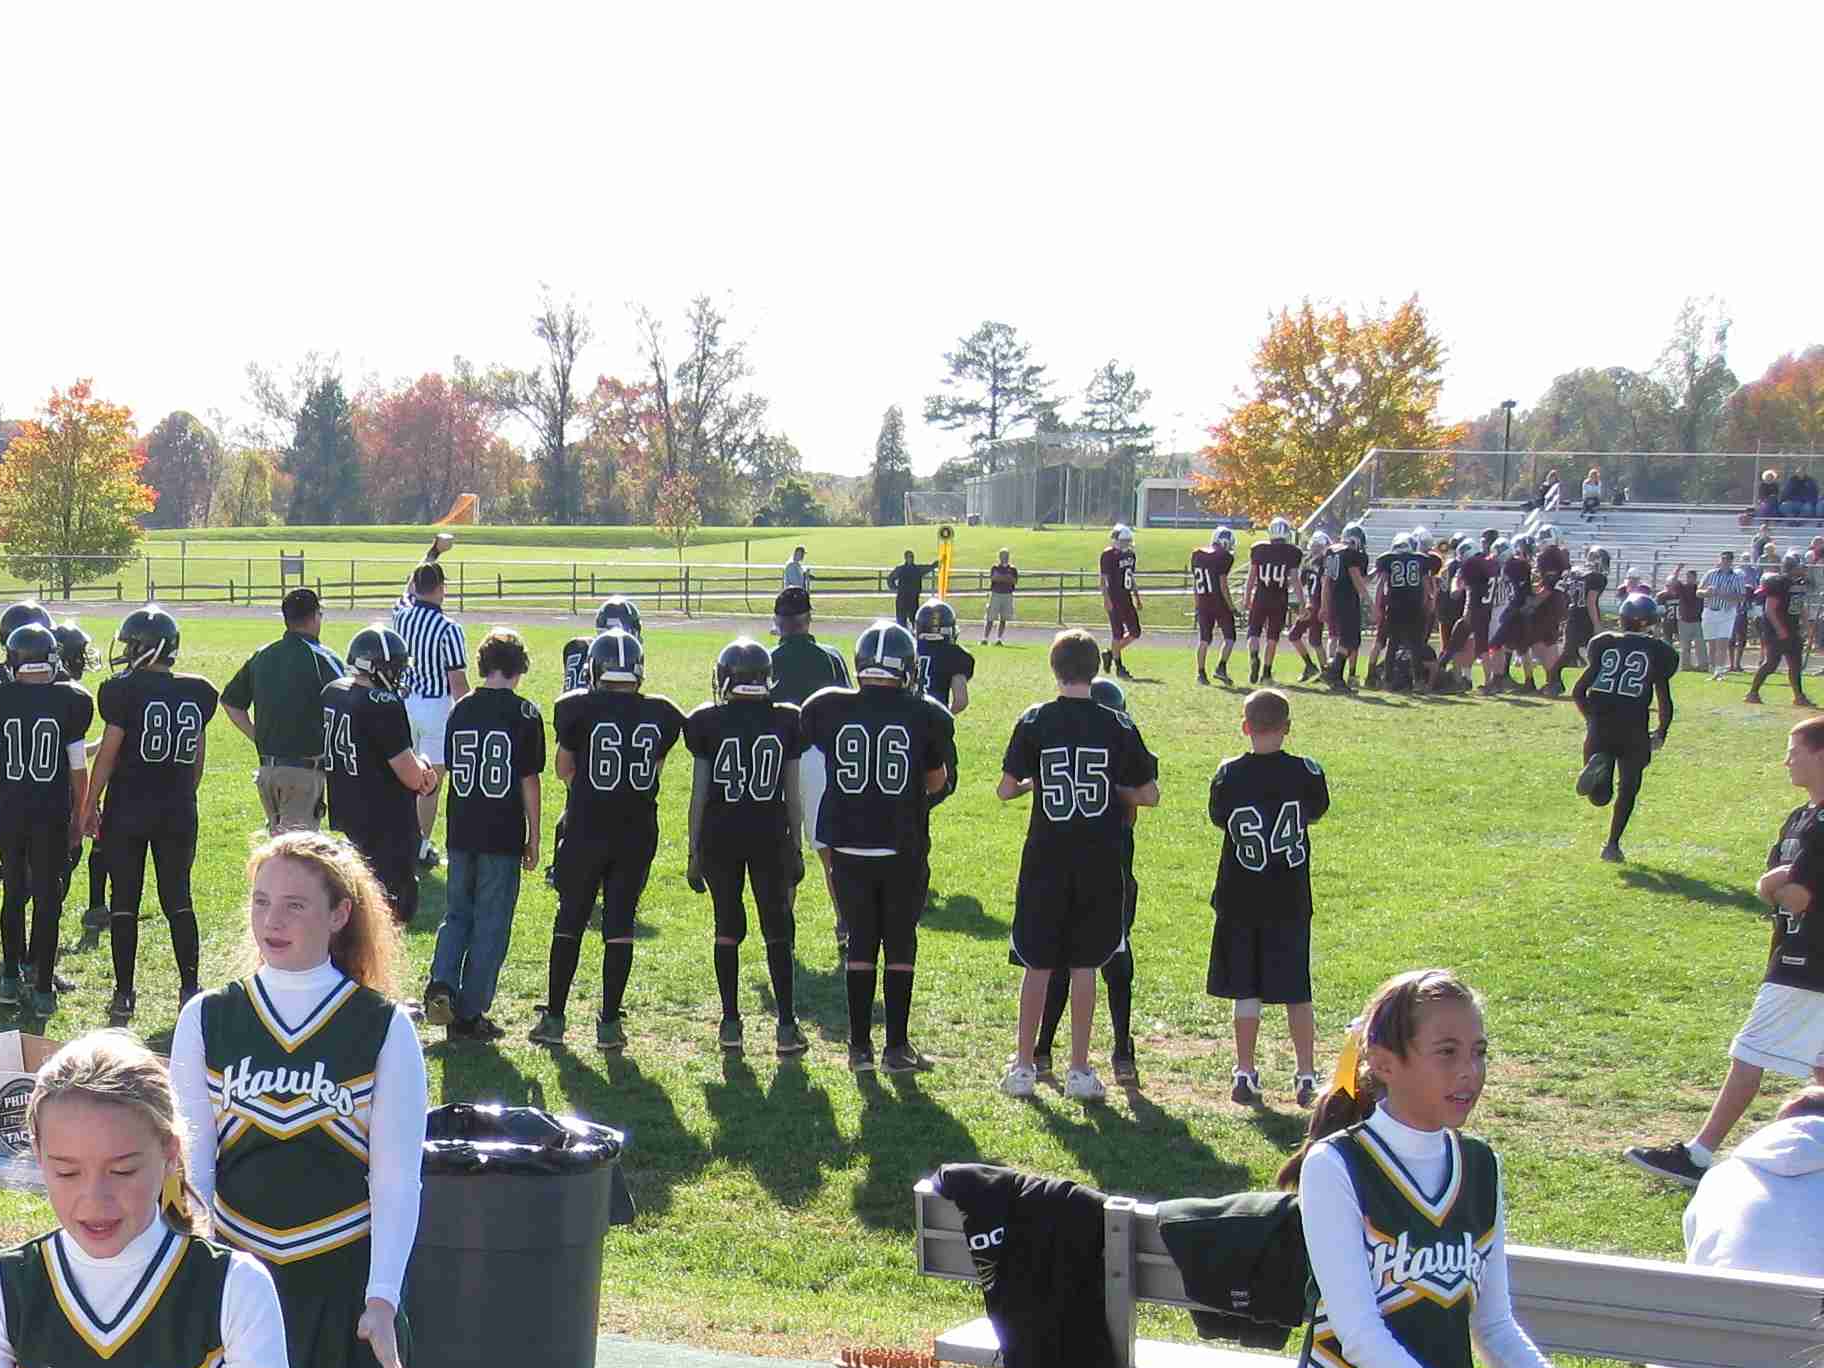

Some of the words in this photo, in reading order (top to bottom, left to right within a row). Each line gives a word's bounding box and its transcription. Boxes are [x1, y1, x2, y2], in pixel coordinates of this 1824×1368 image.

[1194, 567, 1212, 594] 21
[1591, 649, 1649, 698] 22
[3, 718, 61, 782] 10
[140, 701, 203, 764] 82
[451, 730, 513, 798] 58
[588, 722, 663, 791] 63
[835, 724, 910, 794] 96
[713, 734, 784, 802] 40
[1039, 747, 1110, 822] 55
[1227, 801, 1306, 872] 64
[221, 1055, 355, 1118] Hawks
